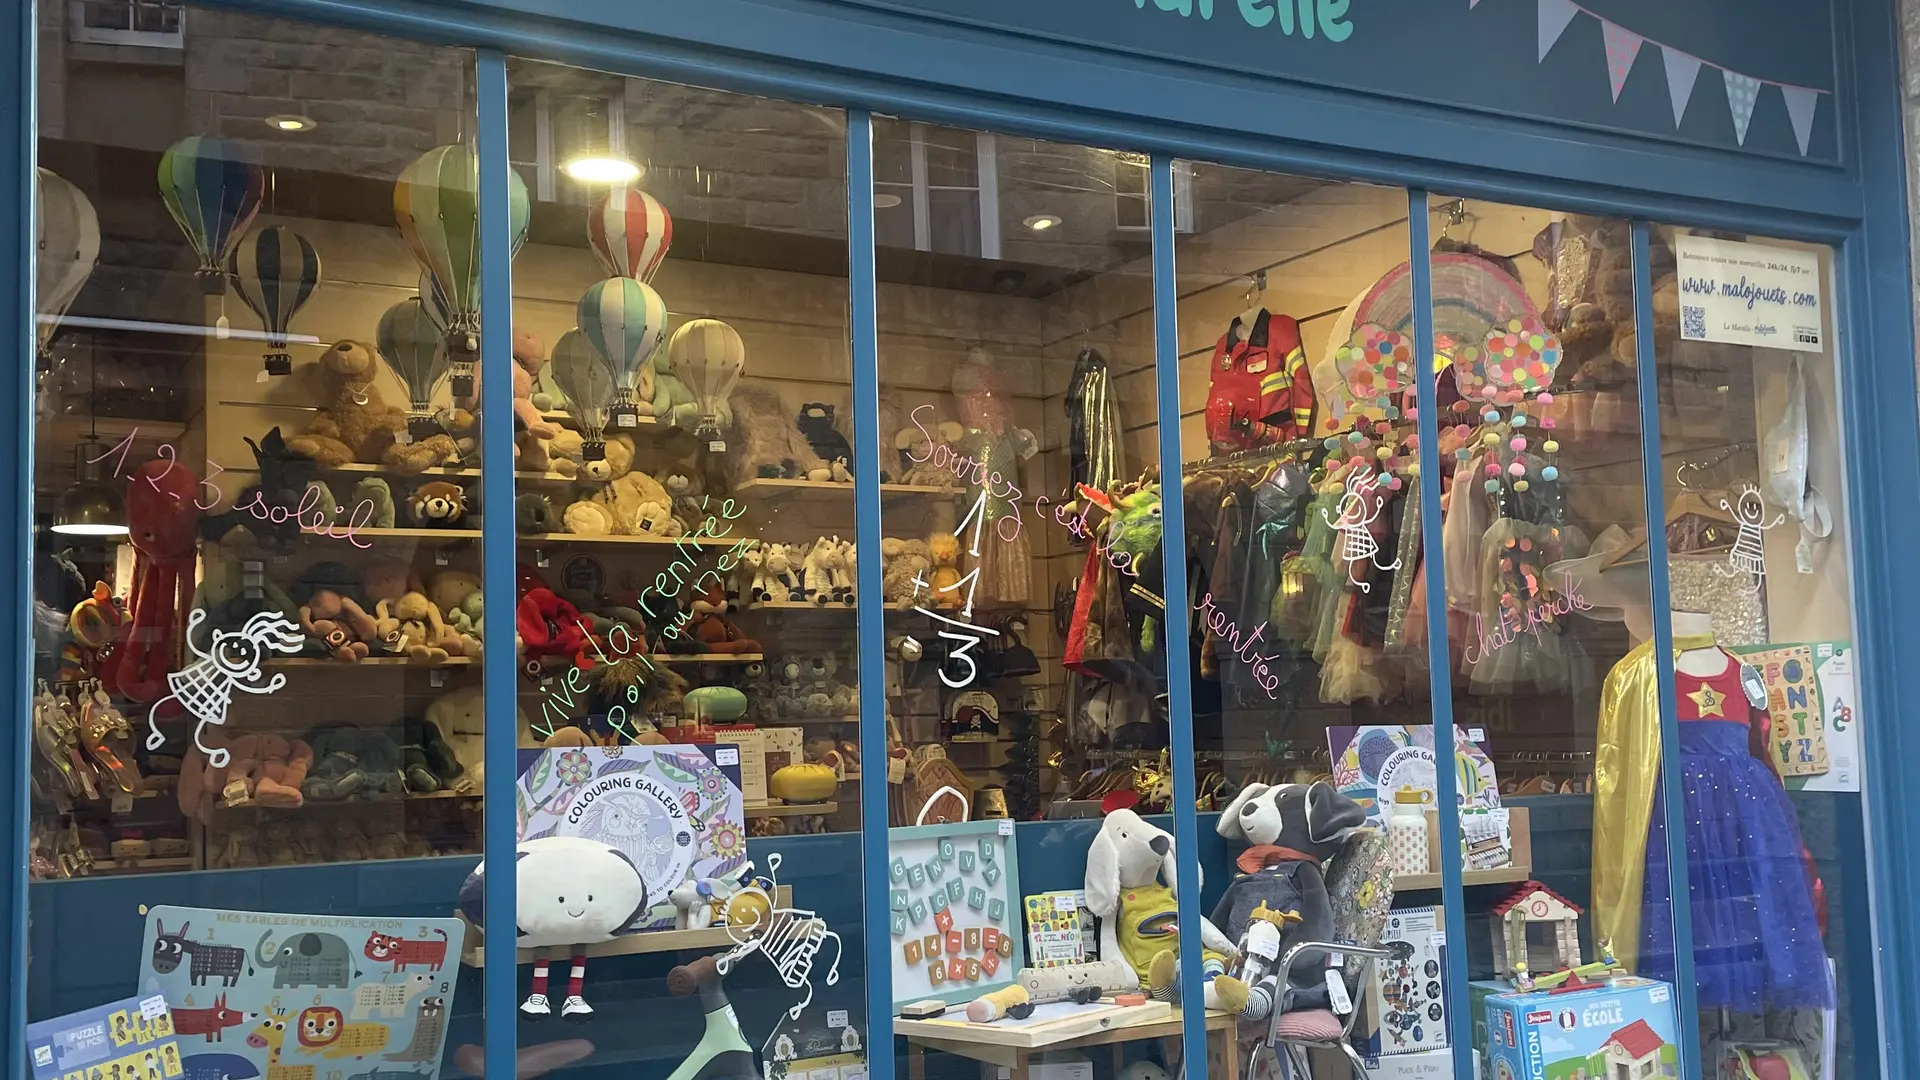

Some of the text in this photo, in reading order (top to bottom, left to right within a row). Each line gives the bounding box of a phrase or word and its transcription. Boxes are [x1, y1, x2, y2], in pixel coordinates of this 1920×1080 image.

[232, 485, 373, 548] soleil
[953, 489, 985, 557] 1
[664, 608, 694, 639] au
[693, 537, 758, 595] nez
[530, 494, 747, 737] vive la rentrée
[1096, 521, 1139, 577] la
[1193, 592, 1280, 700] rentrée
[1465, 606, 1517, 664] chat
[937, 631, 980, 689] 3
[1381, 749, 1420, 787] COLOURING
[568, 777, 684, 825] COLOURING GALLERY
[985, 843, 992, 856] D
[932, 862, 942, 876] N
[965, 855, 973, 868] V
[895, 863, 904, 876] G
[913, 868, 923, 881] E
[988, 869, 997, 880] A
[953, 881, 961, 896] F
[896, 894, 906, 906] N
[936, 894, 945, 907] C
[974, 892, 983, 905] H
[915, 904, 922, 916] P
[244, 914, 288, 927] TABLES
[310, 918, 403, 929] MULTIPLICATION
[895, 918, 905, 931] K
[418, 926, 429, 938] 3
[264, 941, 276, 956] 2
[439, 981, 450, 994] 8
[1582, 1007, 1624, 1029] ÉCOLE
[71, 1025, 103, 1042] PUZZLE
